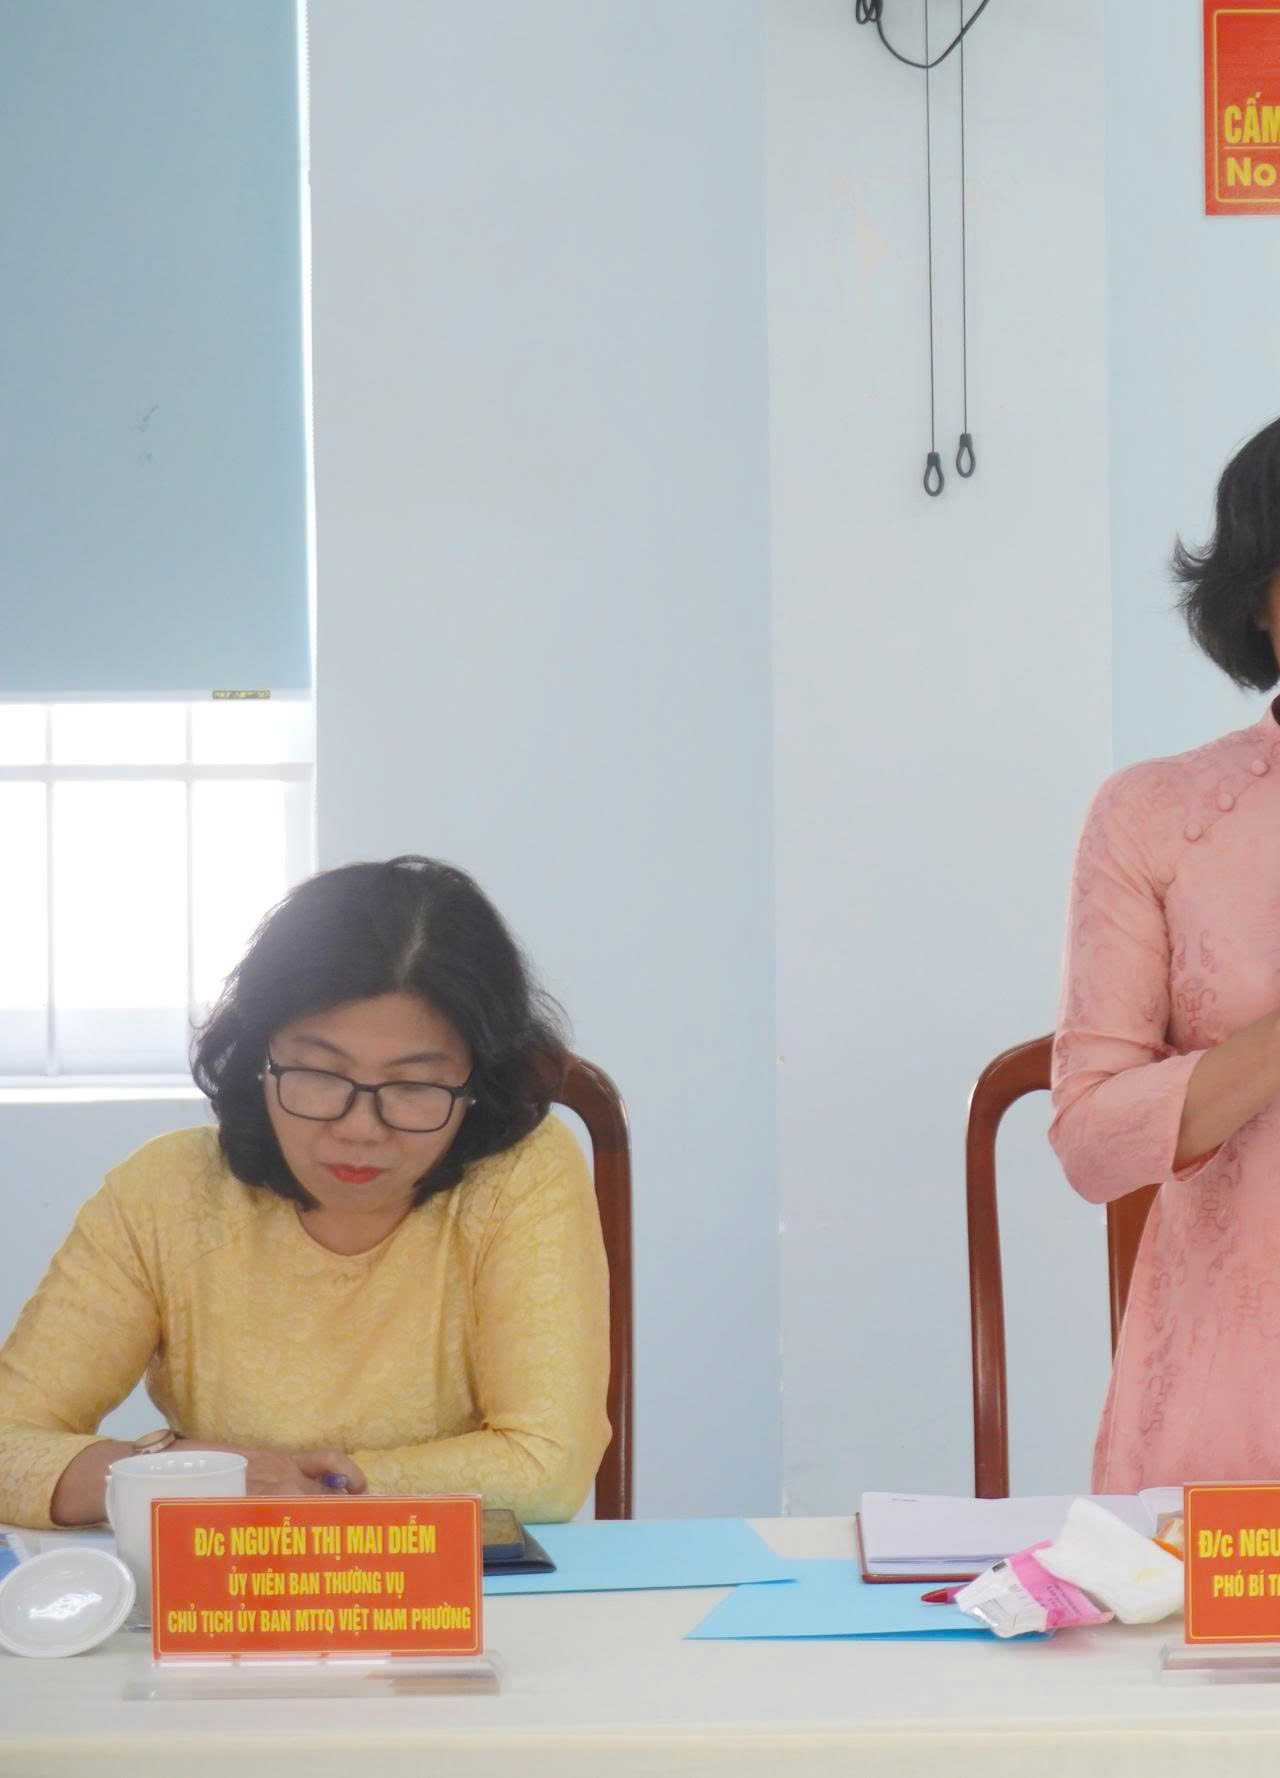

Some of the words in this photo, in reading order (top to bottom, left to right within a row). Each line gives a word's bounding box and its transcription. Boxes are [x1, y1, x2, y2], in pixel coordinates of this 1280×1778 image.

[1226, 157, 1277, 186] No
[194, 1528, 224, 1556] Đ/c
[231, 1516, 306, 1555] NGUYỄN
[312, 1526, 341, 1560] THỊ
[347, 1525, 382, 1554] MAI
[389, 1515, 436, 1554] DIỄM
[1199, 1530, 1233, 1558] Đ/c
[229, 1566, 249, 1596] ỦY
[253, 1568, 285, 1596] VIÊN
[290, 1572, 319, 1595] BAN
[324, 1568, 381, 1595] THƯỜNG
[386, 1571, 404, 1599] VỤ
[1214, 1567, 1244, 1597] PHÓ
[1249, 1567, 1264, 1596] BÍ
[168, 1604, 196, 1633] CHỦ
[202, 1608, 233, 1637] TỊCH
[238, 1603, 258, 1632] ỦY
[261, 1609, 290, 1631] BAN
[296, 1609, 334, 1633] MTTQ
[339, 1603, 368, 1635] VIỆT
[374, 1608, 407, 1630] NAM
[412, 1602, 470, 1629] PHƯỜNG
